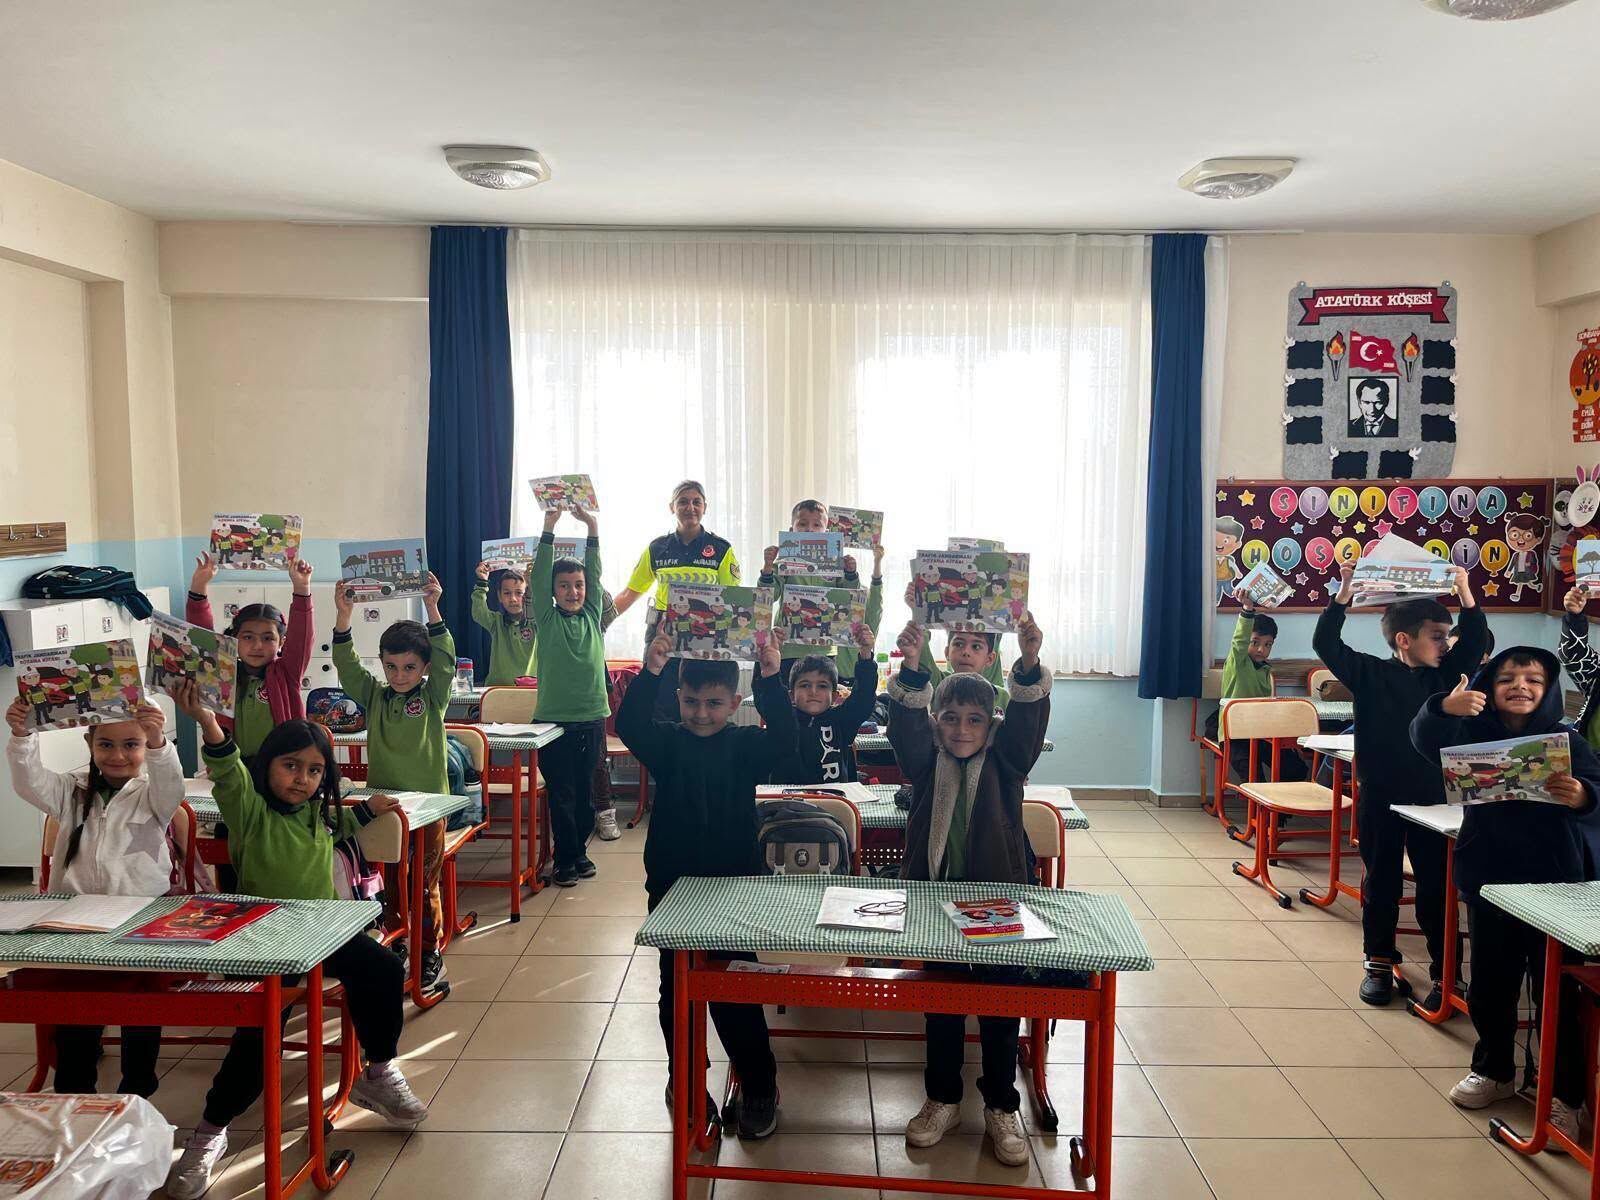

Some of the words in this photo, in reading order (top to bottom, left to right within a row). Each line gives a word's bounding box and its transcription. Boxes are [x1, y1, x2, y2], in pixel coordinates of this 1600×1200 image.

[1314, 294, 1382, 308] ATATÜRK
[1387, 291, 1433, 308] KÖŞESİ
[1279, 493, 1499, 512] SINIFINA
[820, 726, 840, 780] PAR
